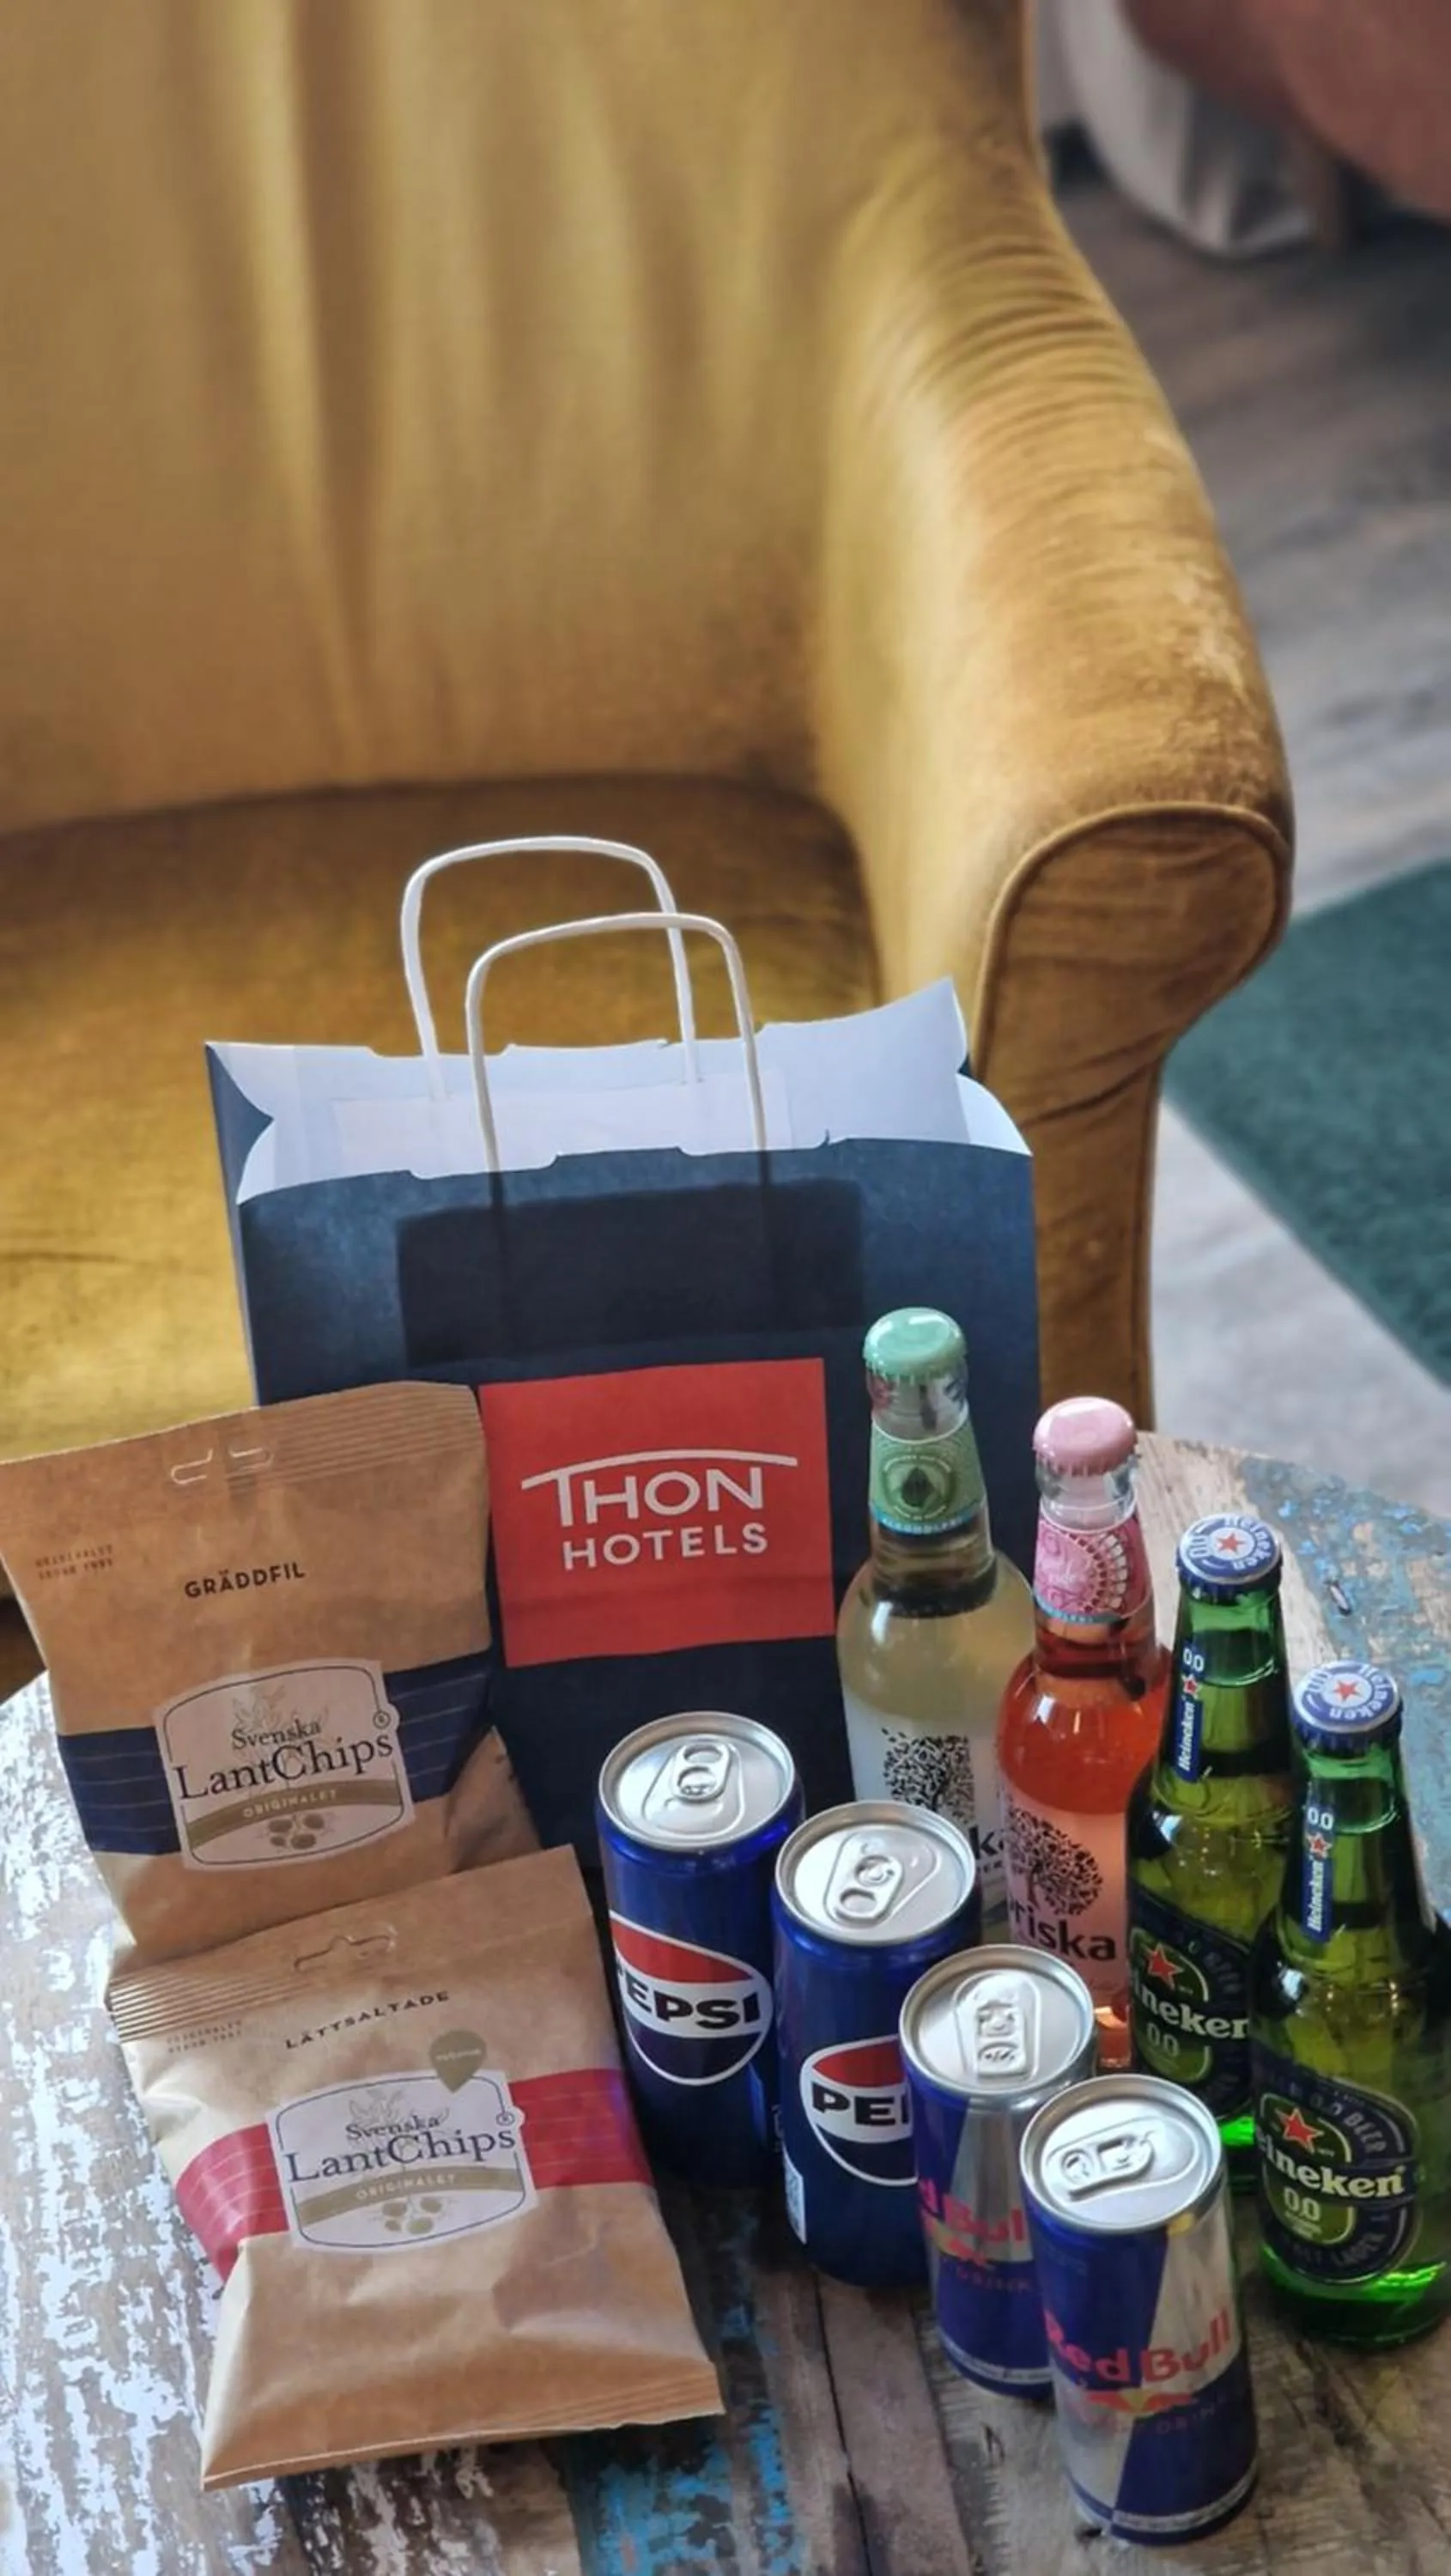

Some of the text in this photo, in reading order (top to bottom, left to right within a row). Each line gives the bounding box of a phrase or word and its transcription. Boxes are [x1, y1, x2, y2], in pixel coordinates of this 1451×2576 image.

[521, 1449, 798, 1527] THON
[562, 1522, 768, 1571] HOTELS
[185, 1561, 306, 1599] GRÄDDFIL
[232, 1718, 322, 1750] Svenska
[1178, 1701, 1195, 1771] Heineken
[173, 1734, 393, 1800] LantChips
[1009, 1898, 1115, 1961] riska
[285, 1990, 450, 2050] LÄTTSALTADE
[617, 1965, 761, 2030] EPSI
[285, 2129, 516, 2182] LantChips
[345, 2115, 440, 2141] Svenska
[1140, 2306, 1231, 2384] Bull
